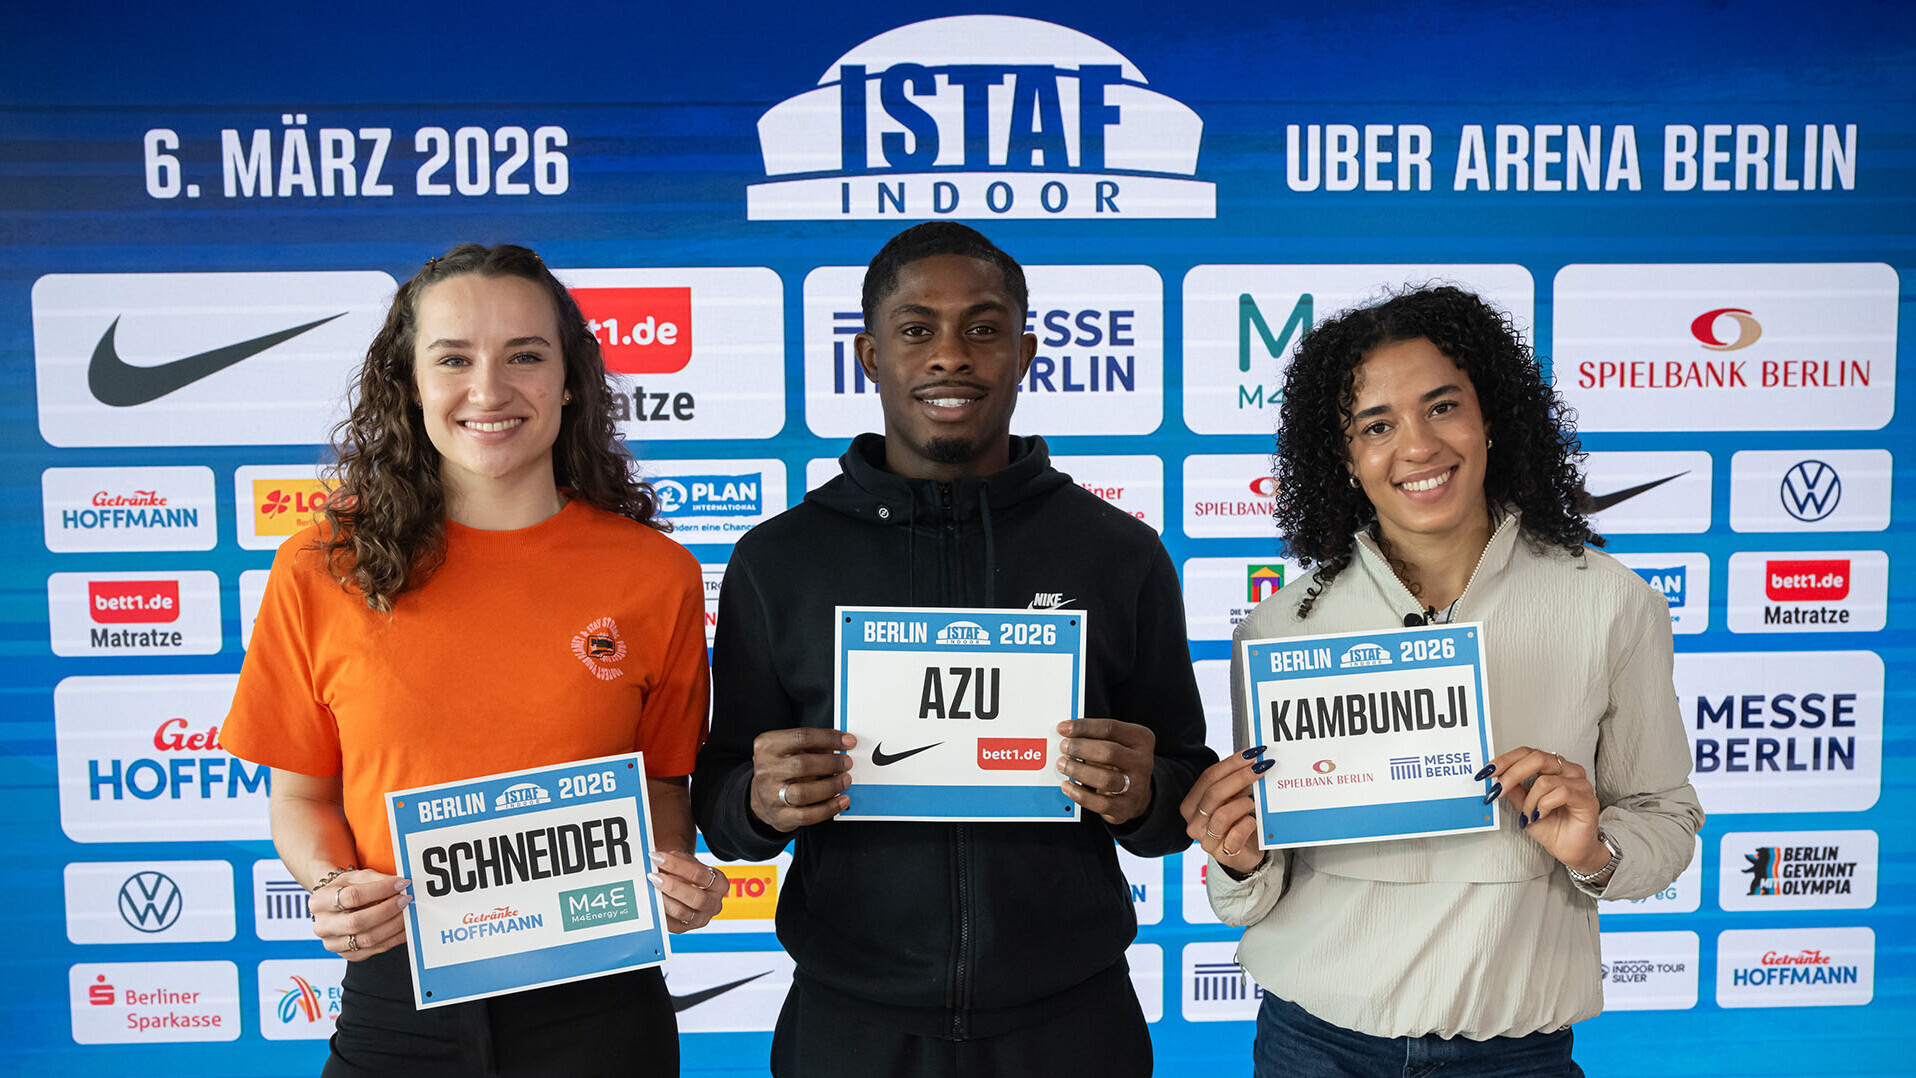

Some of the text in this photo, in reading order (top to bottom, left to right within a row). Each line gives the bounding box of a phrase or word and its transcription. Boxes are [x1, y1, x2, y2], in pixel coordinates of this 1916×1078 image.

[840, 63, 1122, 172] ISTAF
[144, 113, 571, 199] 6. MÄRZ 2026
[1286, 123, 1857, 192] UBER ARENA BERLIN
[841, 180, 1121, 215] INDOOR
[585, 316, 678, 346] t1.de
[1026, 309, 1135, 348] SSE
[1029, 355, 1135, 392] RLIN
[1578, 357, 1871, 390] SPIELBANK BERLIN
[609, 386, 695, 422] atze
[92, 490, 168, 508] Getränke
[692, 482, 757, 502] PLAN
[692, 503, 757, 511] INTERNATIONAL
[62, 508, 199, 530] HOFFMANN
[701, 523, 721, 532] eine
[1771, 573, 1845, 590] bett1.de
[95, 594, 173, 611] bett1.de
[1033, 593, 1063, 607] NIKE
[1764, 606, 1850, 625] Matratze
[90, 628, 183, 649] Matratze
[864, 621, 1057, 646] BERLIN ISTAF 2026
[1270, 638, 1455, 673] BERLIN ISTAF 2026
[918, 666, 1000, 720] AZU
[1271, 685, 1468, 742] KAMBUNDJI
[1696, 693, 1857, 730] MESSE
[982, 748, 1042, 761] bett1.de
[1424, 752, 1471, 766] MESSE
[1695, 736, 1856, 773] BERLIN
[89, 757, 271, 800] HOFFM
[1277, 773, 1374, 790] SPIELBANK BERLIN
[1426, 764, 1473, 778] BERLIN
[418, 771, 617, 824] BERLIN ISTAF 2026
[422, 815, 632, 898] SCHNEIDER
[1783, 846, 1839, 862] BERLIN
[1783, 863, 1857, 879] GEWINNT
[1782, 880, 1851, 896] OLYMPIA
[568, 886, 627, 916] M4E
[462, 905, 519, 926] Getränke
[571, 910, 619, 924] M4Energy
[441, 912, 544, 944] HOFFMANN
[1612, 963, 1685, 974] INDOOR TOUR
[1762, 950, 1831, 966] Getränke
[1612, 974, 1647, 983] SILVER
[1733, 966, 1858, 987] HOFFMANN
[126, 989, 200, 1006] Berliner
[127, 1012, 222, 1032] Sparkasse
